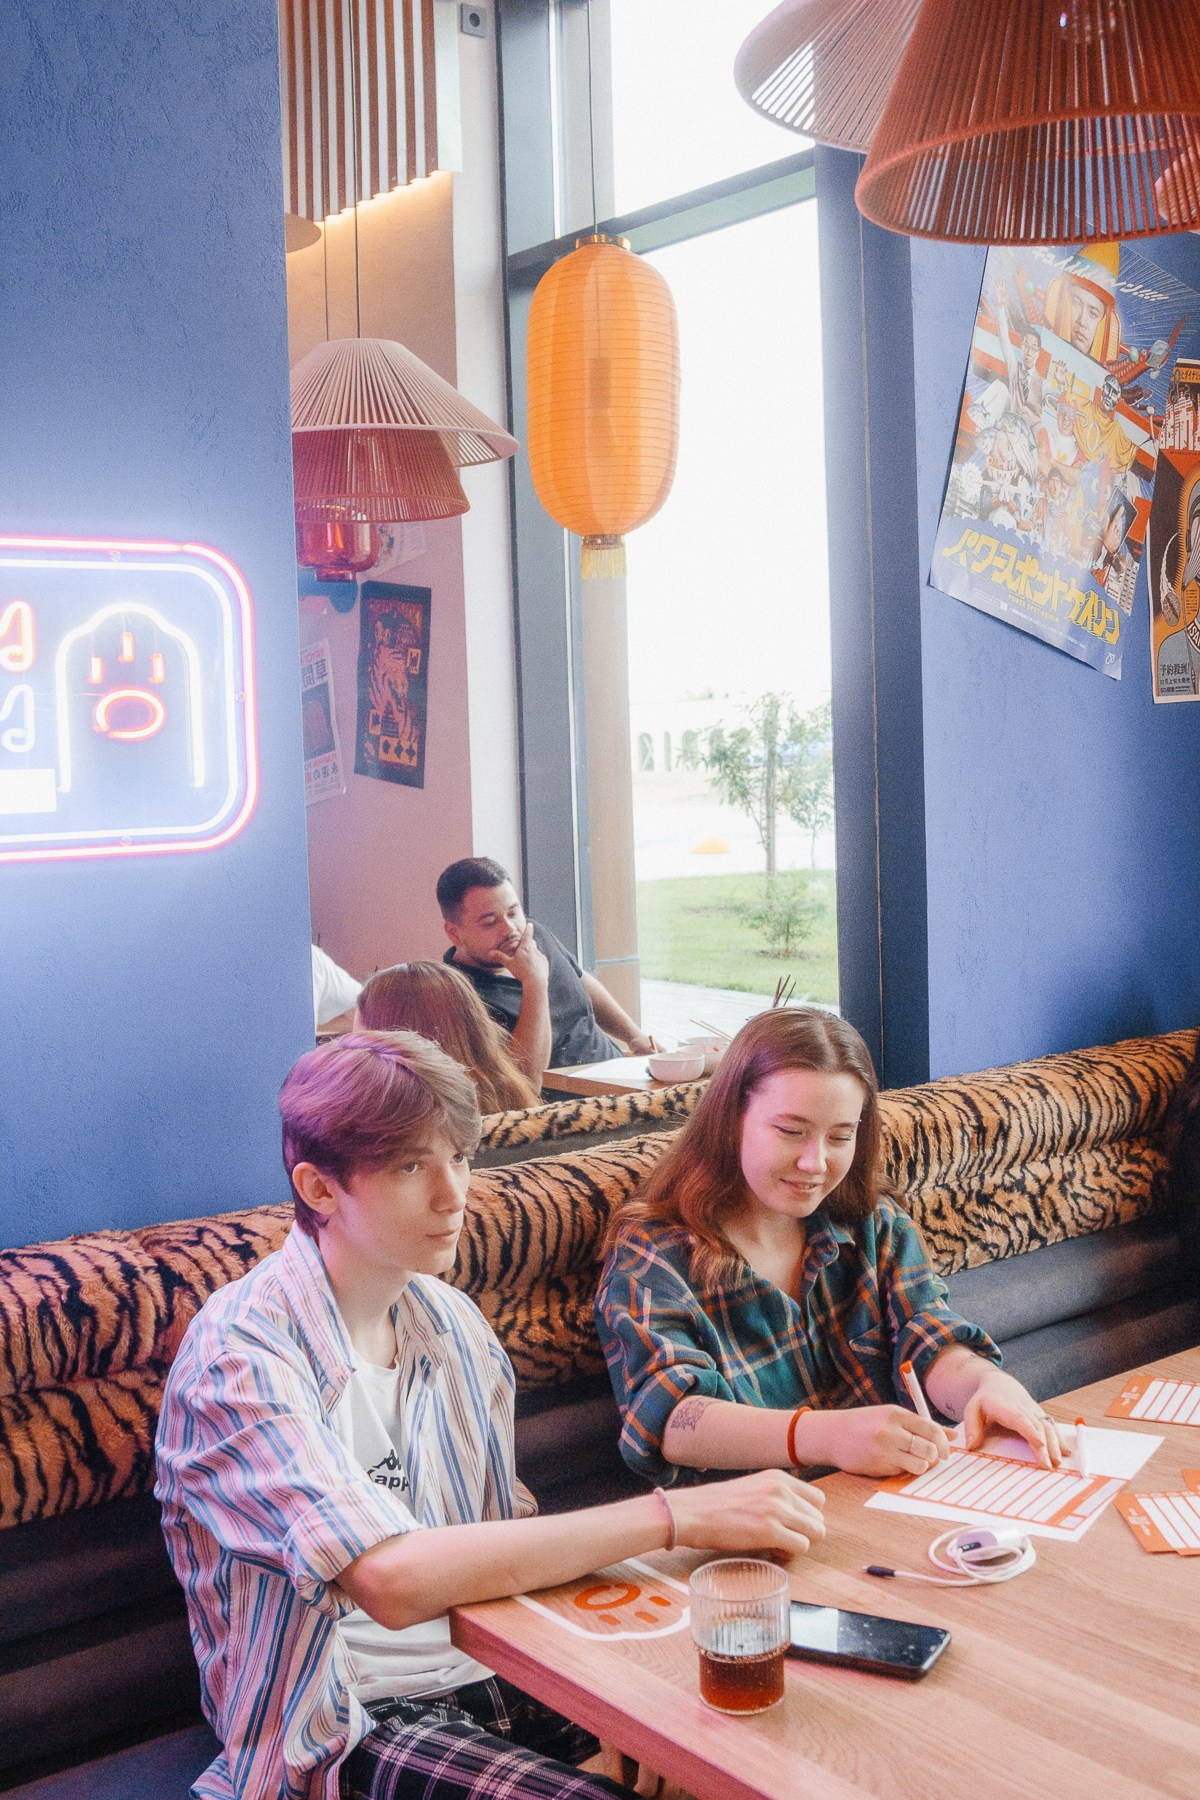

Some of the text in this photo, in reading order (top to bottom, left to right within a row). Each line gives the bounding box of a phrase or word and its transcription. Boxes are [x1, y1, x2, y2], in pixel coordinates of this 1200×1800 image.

[942, 528, 1121, 645] パワースポットケイリン
